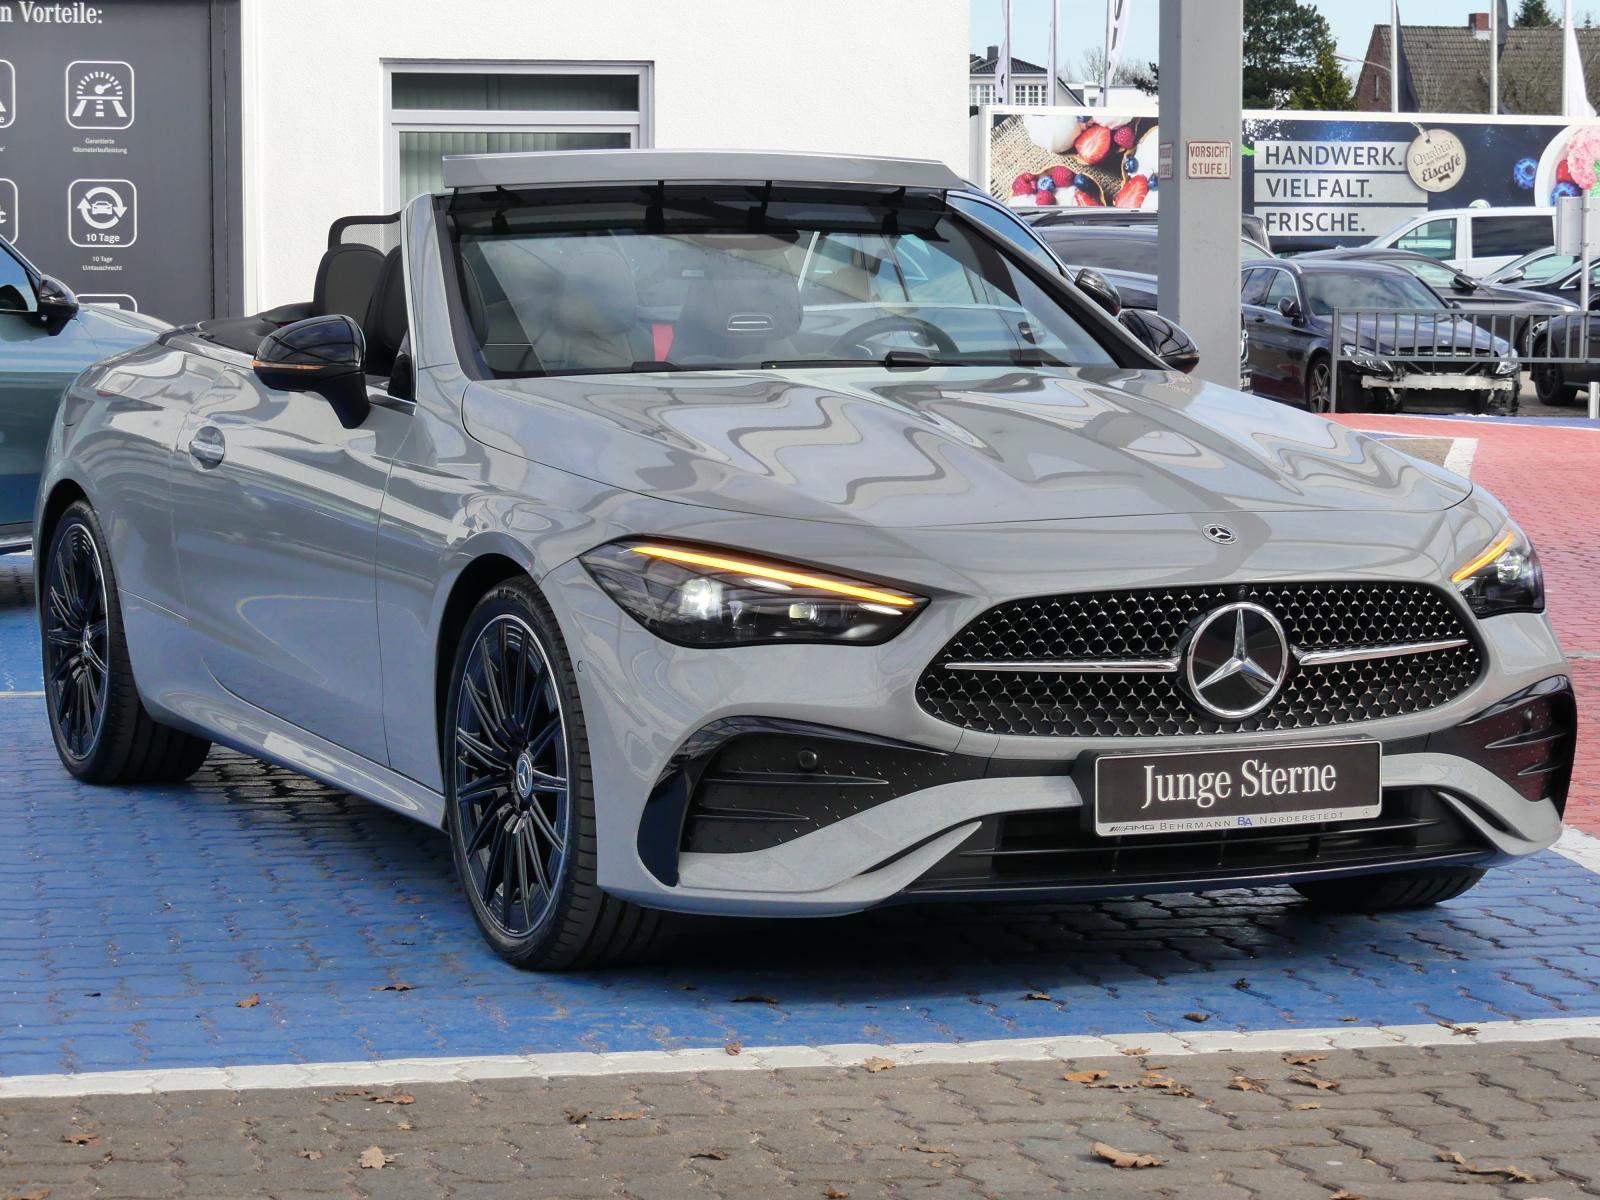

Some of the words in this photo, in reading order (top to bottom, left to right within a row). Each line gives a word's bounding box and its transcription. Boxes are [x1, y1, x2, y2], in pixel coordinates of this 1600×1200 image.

[18, 1, 103, 24] Vorteile:
[1190, 146, 1230, 158] VORSICHT
[1265, 145, 1403, 166] HANDWERK.
[1191, 162, 1228, 175] STUFE!
[1422, 153, 1461, 182] Eiscafé
[1266, 178, 1373, 198] VIELFALT.
[1265, 212, 1366, 232] FRISCHE.
[86, 233, 97, 242] 10
[98, 233, 120, 244] Tage
[1141, 765, 1232, 808] Junge
[1241, 759, 1336, 798] Sterne
[1160, 820, 1231, 831] BEHRMANN
[1259, 811, 1344, 825] NORDERSTEDT
